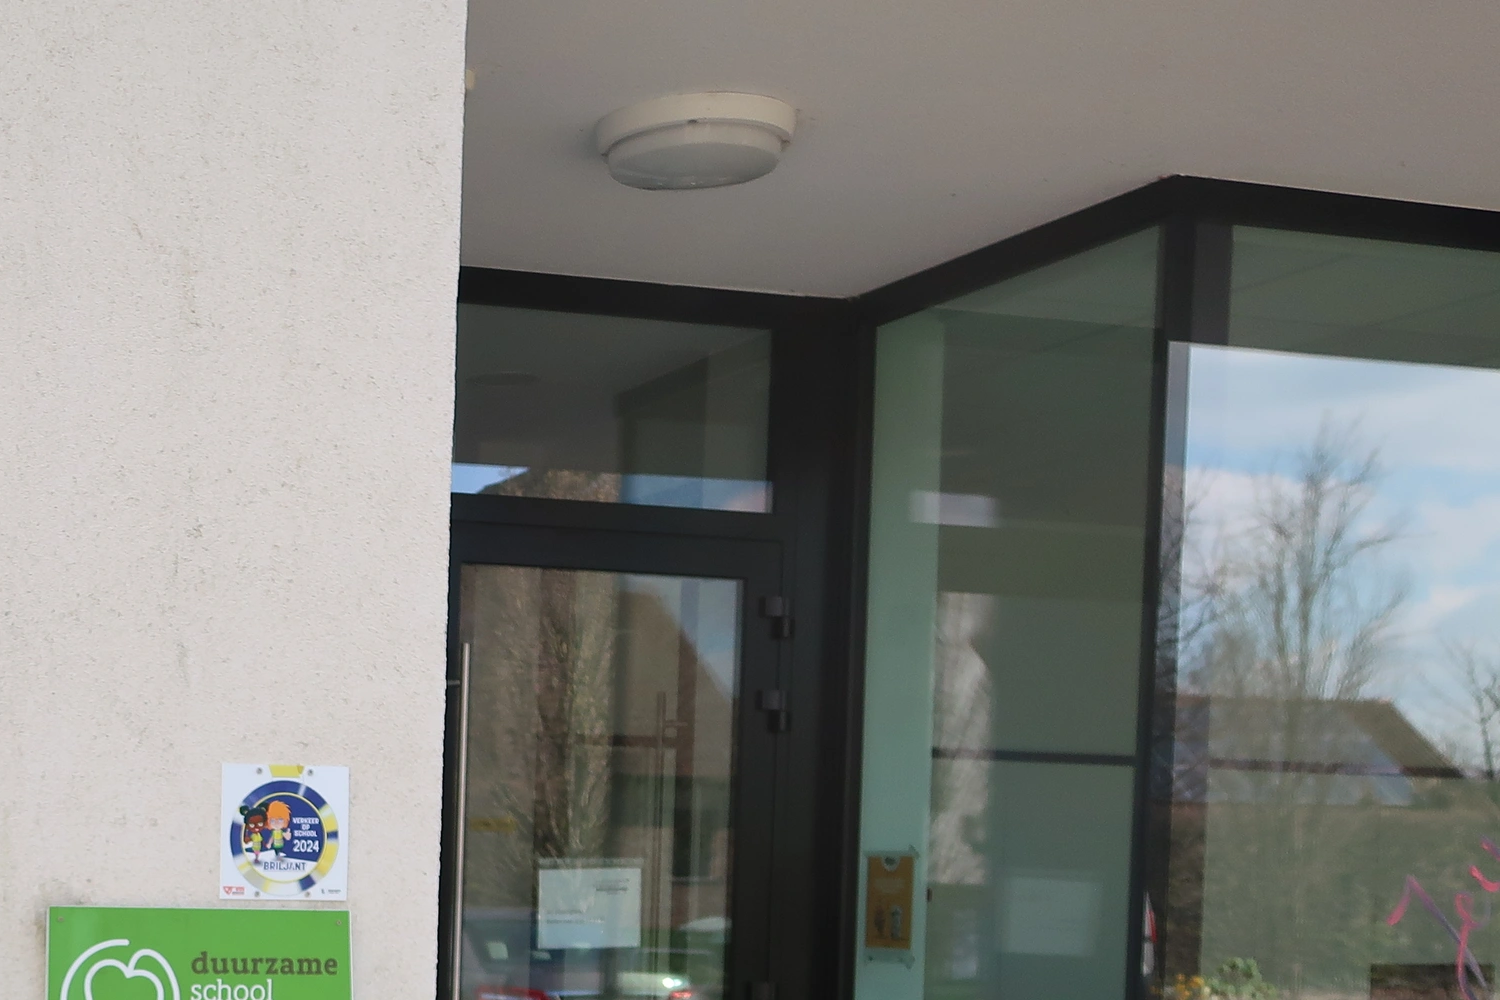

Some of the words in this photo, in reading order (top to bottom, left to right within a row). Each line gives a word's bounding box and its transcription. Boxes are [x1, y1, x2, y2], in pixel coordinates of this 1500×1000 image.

[292, 839, 320, 853] 2024
[263, 861, 306, 871] BRILJANT
[191, 951, 338, 975] duurzame
